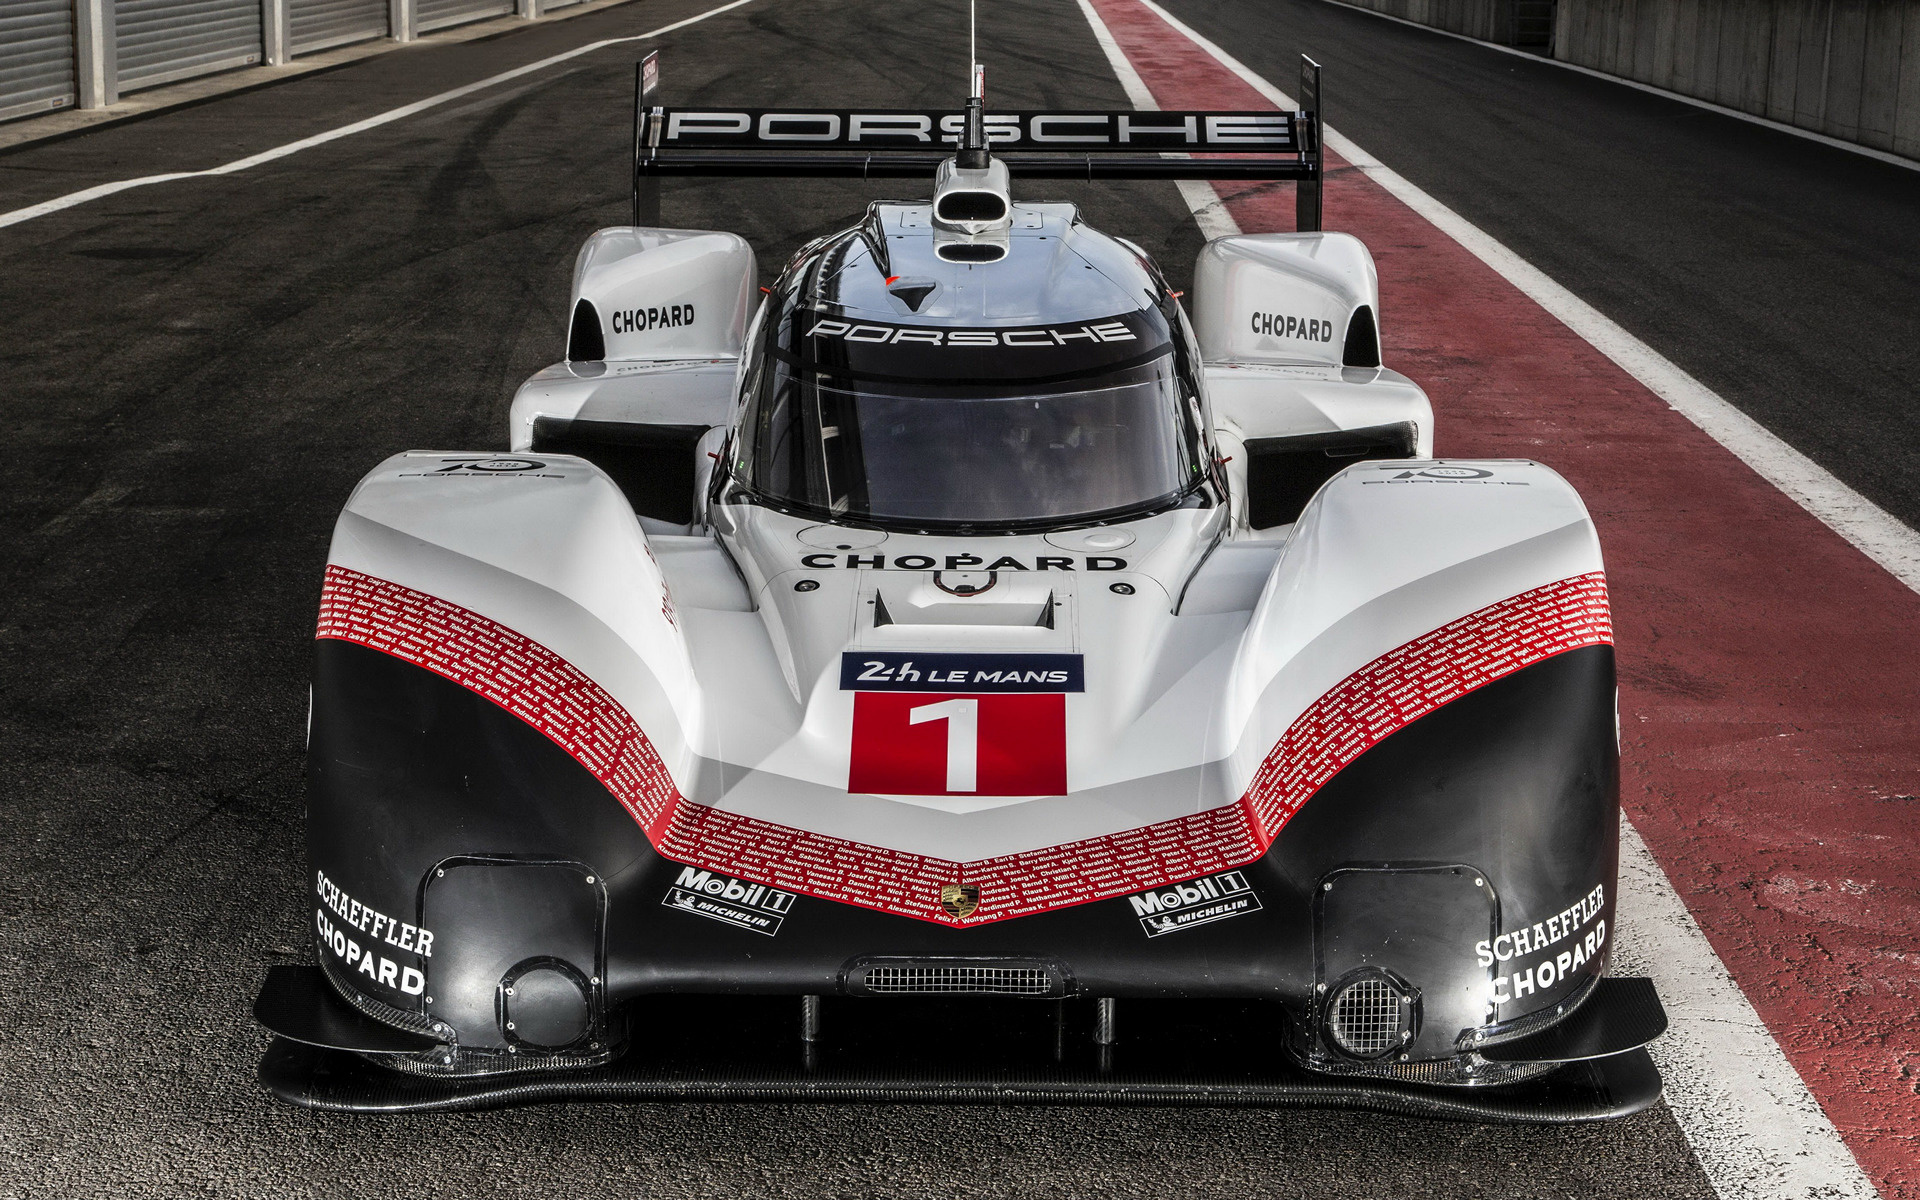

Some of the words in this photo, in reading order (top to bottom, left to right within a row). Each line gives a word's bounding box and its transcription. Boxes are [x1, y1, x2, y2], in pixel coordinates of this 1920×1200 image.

[667, 113, 1289, 144] PORSCHE
[613, 304, 694, 334] CHOPARD
[806, 320, 1137, 346] PORSCHE
[1252, 311, 1333, 343] CHOPARD
[801, 554, 1128, 572] CHOPARD
[473, 652, 491, 664] Frank
[500, 665, 525, 682] Michael
[533, 685, 554, 700] Rainer
[564, 705, 585, 724] Verena
[524, 650, 544, 663] Aaron
[552, 665, 572, 681] Lothar
[581, 686, 602, 704] Daniel
[608, 709, 627, 728] Daniel
[857, 661, 920, 682] 24h
[927, 670, 969, 683] LE
[973, 670, 1068, 683] MANS
[1291, 704, 1319, 732] Alexander
[1326, 679, 1352, 699] Andreas
[1358, 661, 1380, 676] Daniel
[1387, 647, 1408, 659] Holger
[484, 689, 503, 702] Armin
[510, 704, 536, 723] Andreas
[544, 725, 567, 745] Torsten
[576, 751, 598, 771] Philipp
[909, 698, 978, 792] 1
[1265, 758, 1286, 784] Clemens
[1292, 734, 1309, 750] Peter
[1318, 708, 1341, 724] Tobias
[1349, 690, 1366, 701] Lars
[1374, 672, 1396, 686] Moritz
[1402, 659, 1422, 670] Klaus
[1314, 769, 1333, 786] Deniz
[1339, 746, 1363, 764] Martin
[1371, 725, 1394, 741] Martin
[1401, 707, 1426, 722] Matteo
[710, 809, 738, 821] Christos
[748, 819, 798, 835] Bernd-Michael
[808, 833, 842, 845] Sebastian
[854, 843, 883, 853] Gerhard
[895, 851, 912, 860] Timo
[923, 857, 952, 867] Michael
[712, 831, 739, 843] Luciano
[759, 844, 786, 854] Michele
[798, 852, 825, 863] Sabrina
[836, 861, 852, 869] Ivan
[901, 875, 931, 886] Brendon
[1018, 849, 1048, 859] Stefanie
[1109, 830, 1140, 839] Veronika
[1149, 821, 1178, 830] Stephan
[1186, 814, 1206, 822] Oliver
[1215, 807, 1235, 815] Klaus
[675, 866, 766, 906] Mobil
[773, 893, 786, 909] 1
[981, 886, 1010, 896] Andreas
[1021, 879, 1043, 888] Bernd
[1079, 865, 1114, 876] Sebastian
[1124, 856, 1152, 866] Michael
[1128, 878, 1220, 916] Mobil
[1224, 875, 1239, 890] 1
[317, 870, 434, 957] SCHAEFFLER
[697, 902, 770, 927] MICHELIN
[812, 887, 842, 898] Gerhard
[852, 896, 876, 906] Reiner
[886, 904, 923, 916] Alexander
[933, 913, 951, 922] Felix
[961, 913, 997, 924] Wolfgang
[1007, 905, 1037, 915] Thomas
[1048, 896, 1083, 907] Alexander
[1093, 885, 1132, 898] Dominique
[1177, 900, 1247, 923] MICHELIN
[1475, 884, 1604, 968] SCHAEFFLER
[317, 909, 425, 995] CHOPARD
[1487, 919, 1605, 1003] CHOPARD
